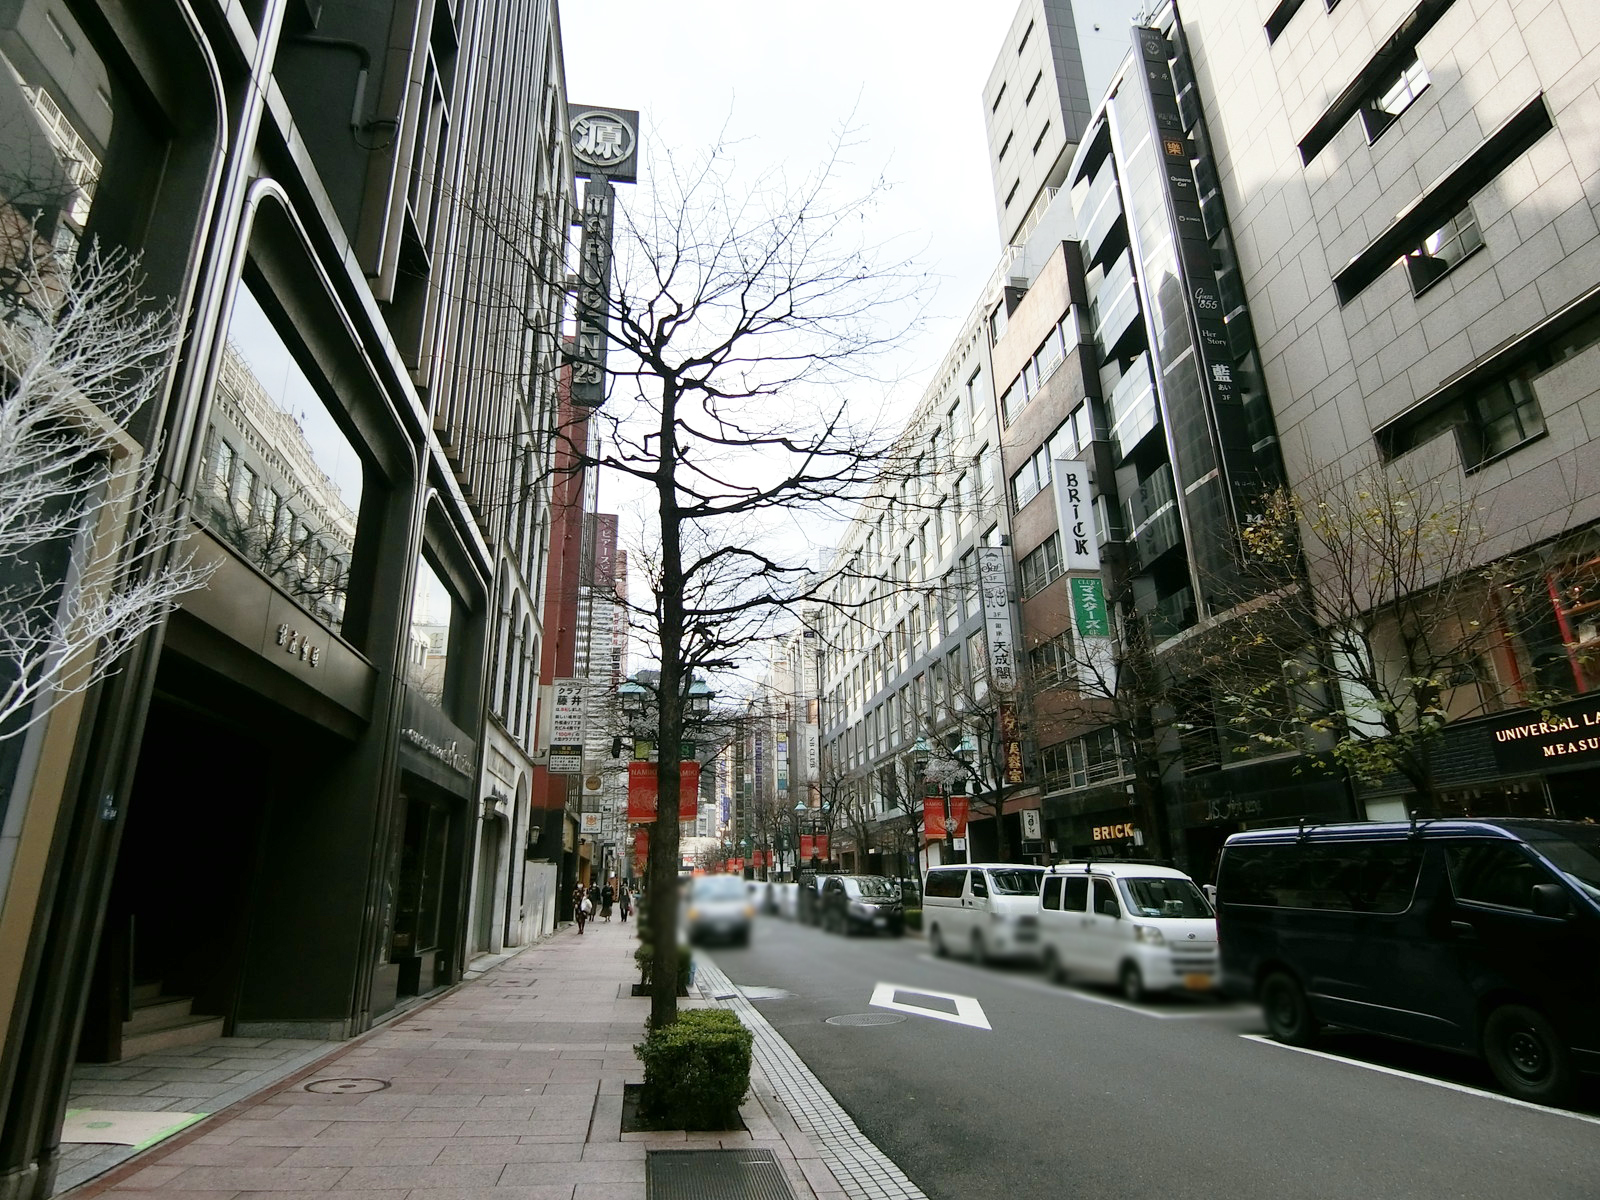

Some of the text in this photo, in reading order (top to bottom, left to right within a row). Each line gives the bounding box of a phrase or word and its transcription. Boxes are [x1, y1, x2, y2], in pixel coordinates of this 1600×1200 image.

[575, 118, 624, 159] 源
[1199, 300, 1218, 310] 855
[1202, 329, 1217, 338] Her
[1207, 337, 1227, 346] Story
[573, 360, 602, 384] 25
[1066, 473, 1089, 556] BRICK
[558, 687, 582, 695] クラブ
[556, 695, 582, 706] 藤井
[1495, 717, 1579, 742] UNIVERSAL
[1542, 737, 1600, 757] MEASU
[1092, 823, 1135, 841] BRICK
